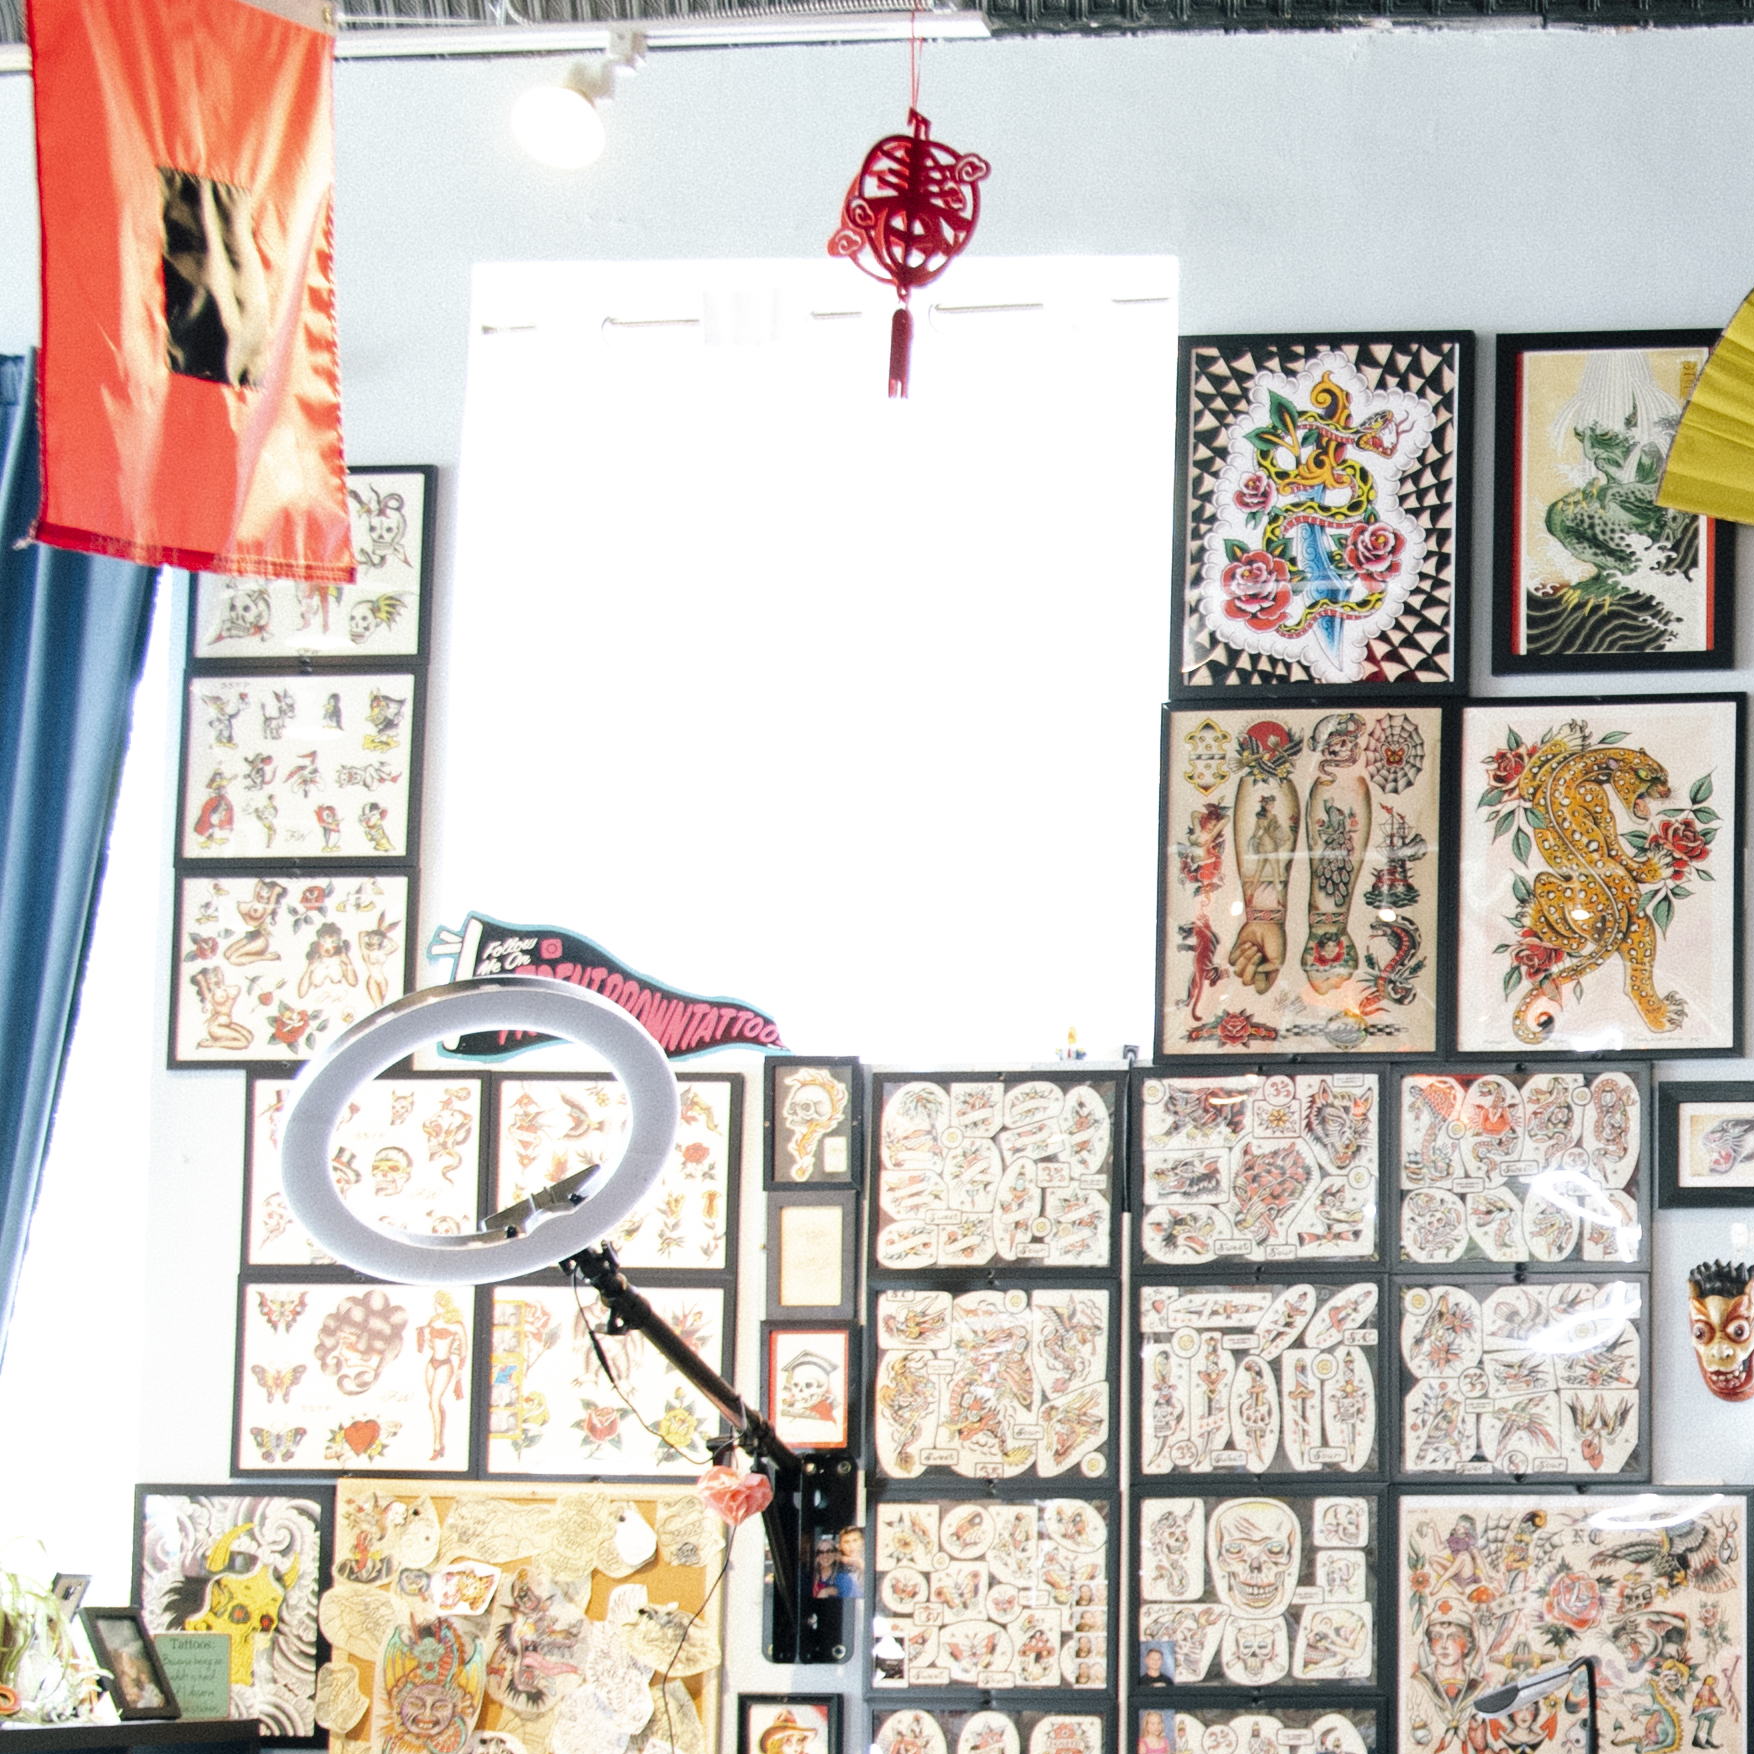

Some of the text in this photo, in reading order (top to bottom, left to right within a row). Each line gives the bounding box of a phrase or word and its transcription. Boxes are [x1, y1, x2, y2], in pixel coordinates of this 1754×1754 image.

[484, 936, 538, 960] Follow
[476, 951, 532, 977] Me On
